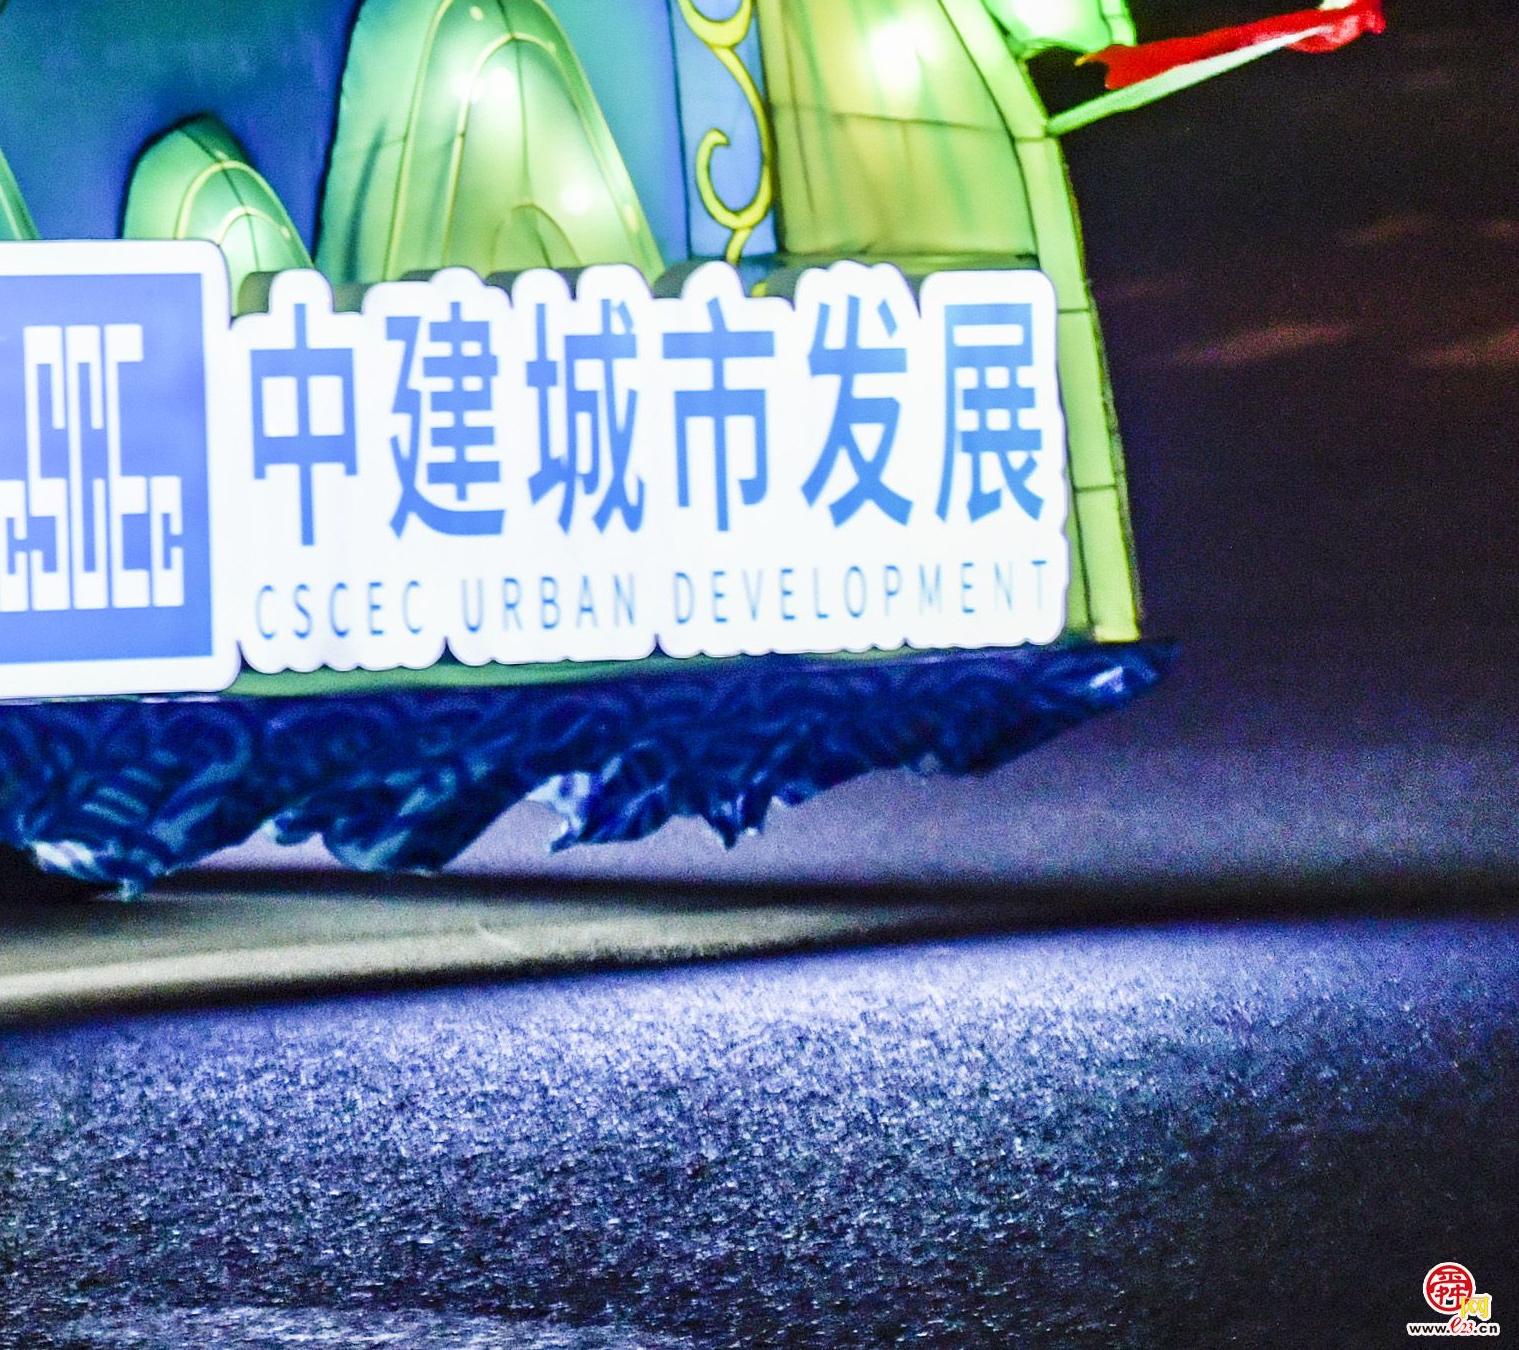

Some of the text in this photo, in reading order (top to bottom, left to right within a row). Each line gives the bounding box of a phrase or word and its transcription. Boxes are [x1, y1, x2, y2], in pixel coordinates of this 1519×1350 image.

[248, 292, 1045, 548] 中建城市发展
[254, 559, 1048, 641] CSCEC URBAN DEVELOPMENT
